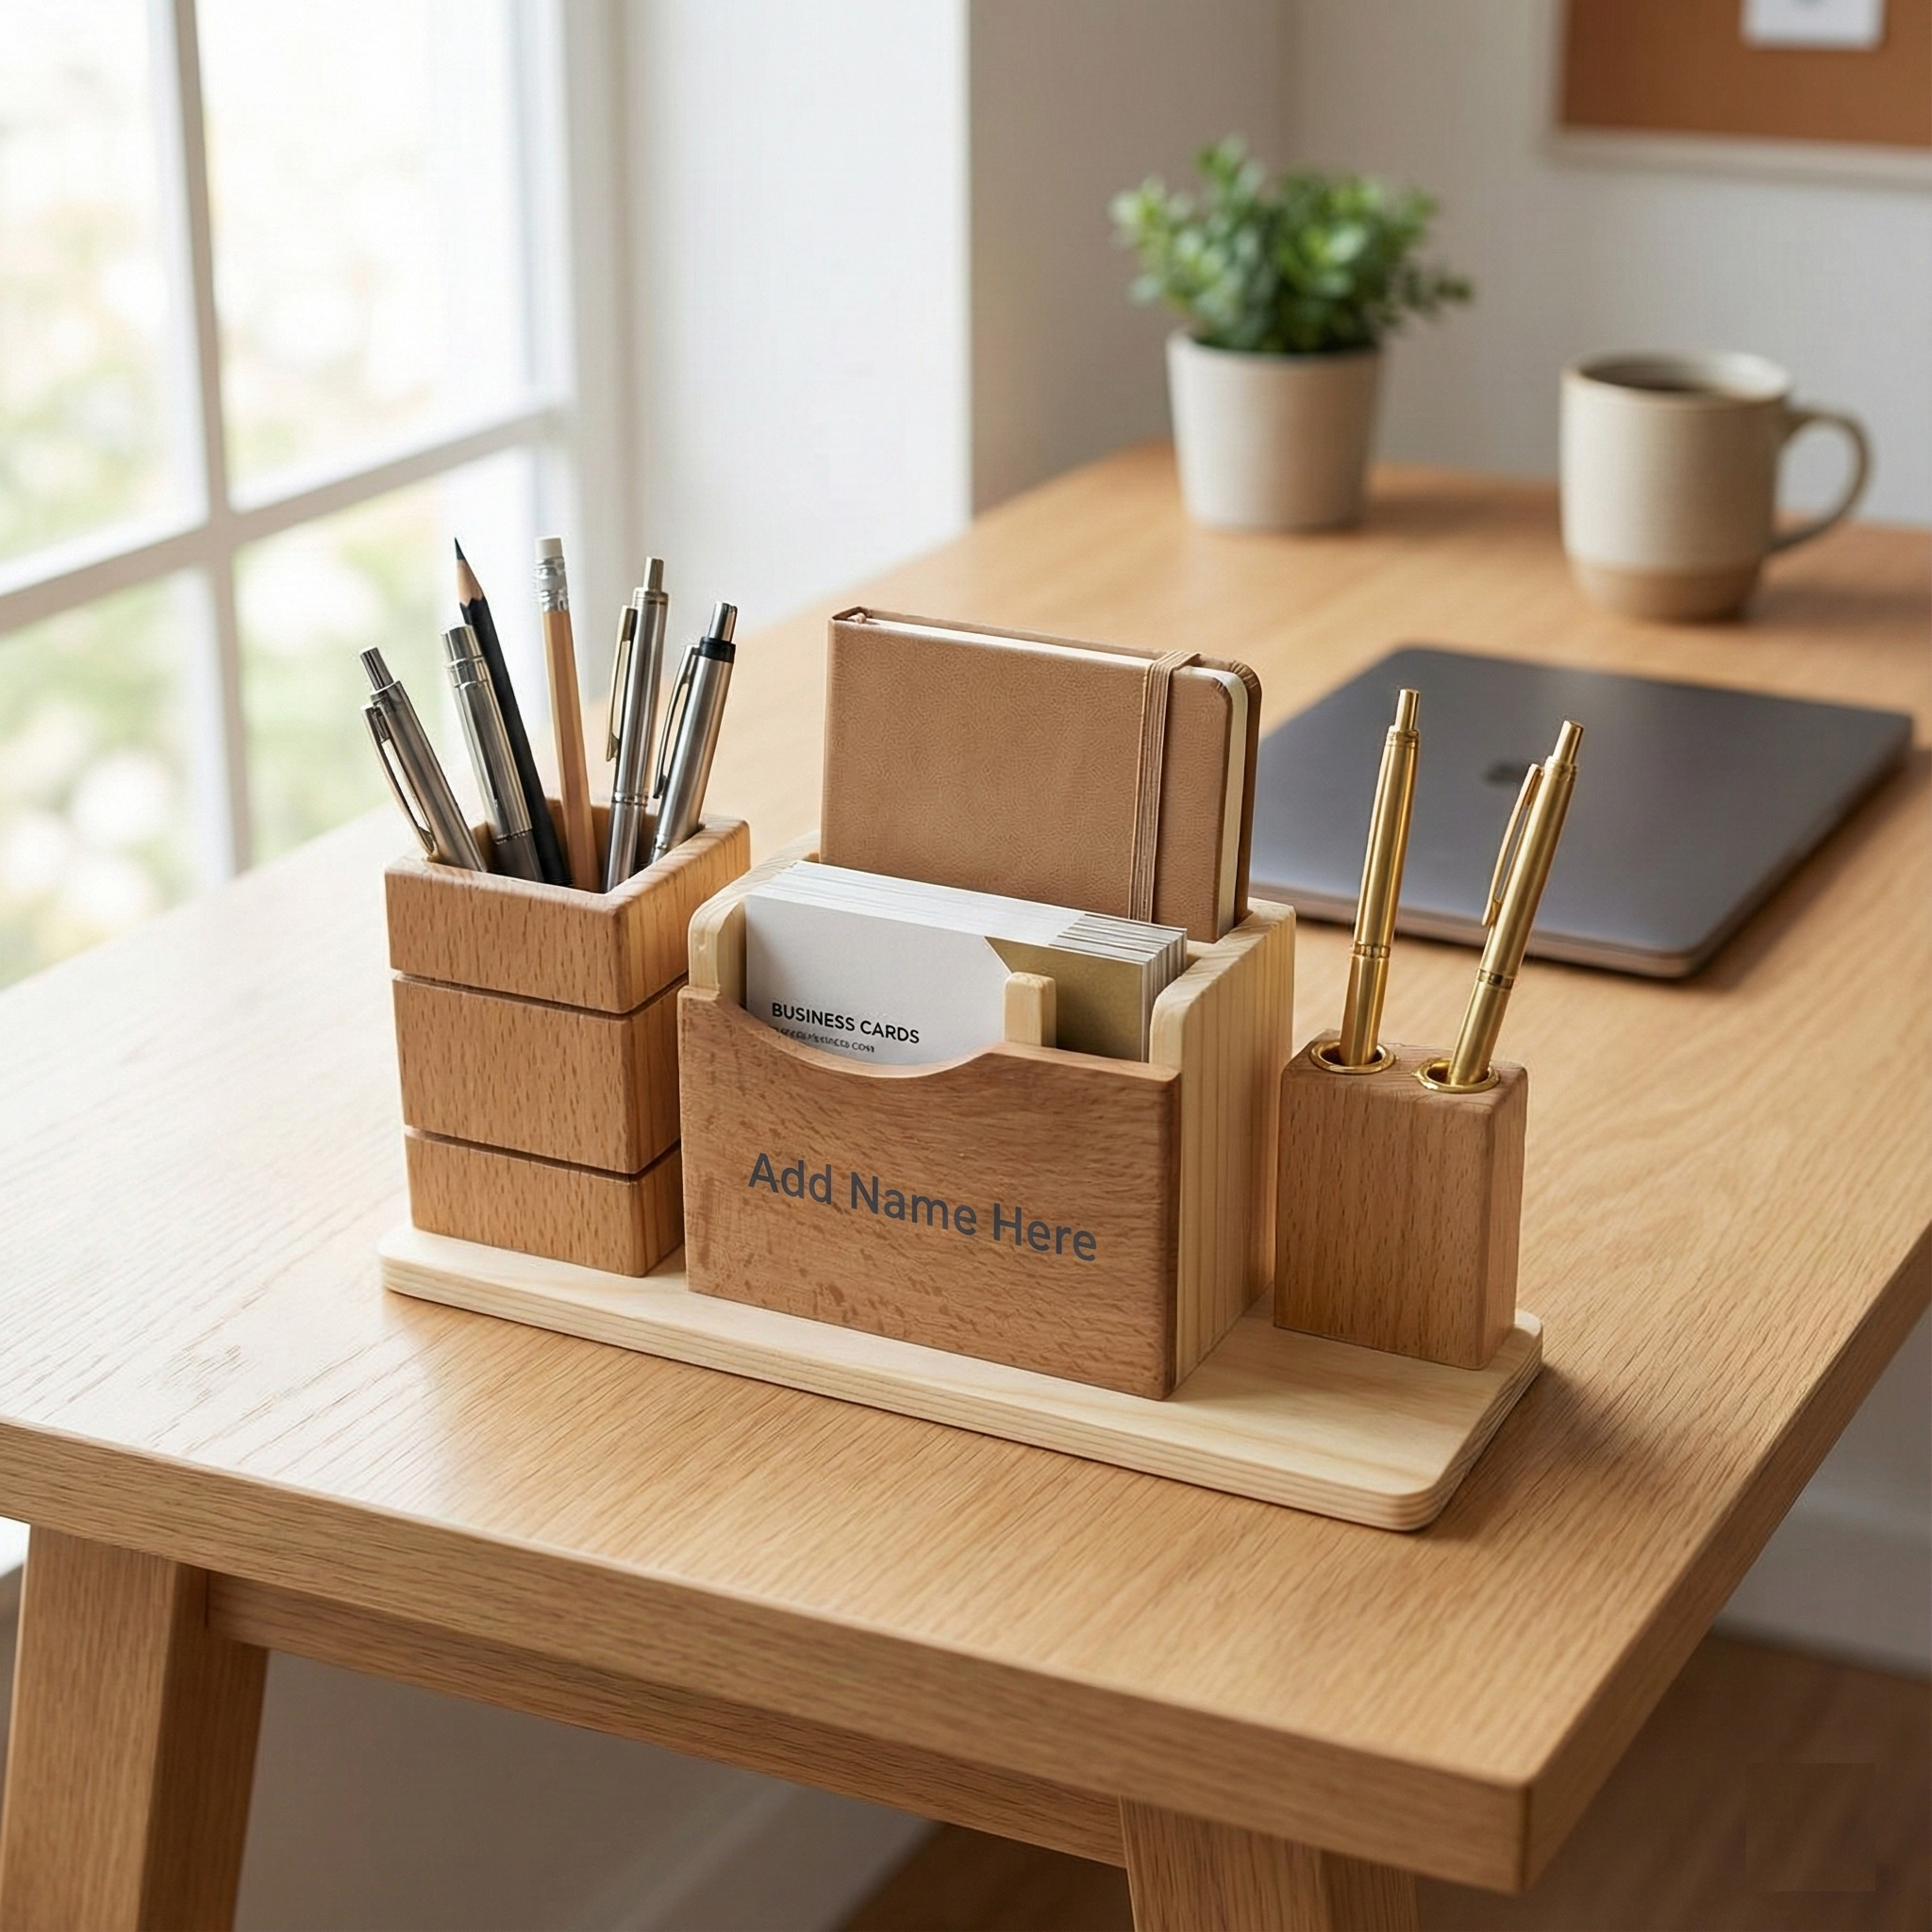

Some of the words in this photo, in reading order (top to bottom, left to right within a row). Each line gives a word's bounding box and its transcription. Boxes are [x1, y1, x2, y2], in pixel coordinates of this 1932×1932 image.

[772, 1002, 856, 1032] BUSINESS
[859, 1020, 920, 1044] CARDS
[748, 1153, 832, 1206] Add
[851, 1171, 977, 1237] Name
[992, 1203, 1097, 1262] Here
